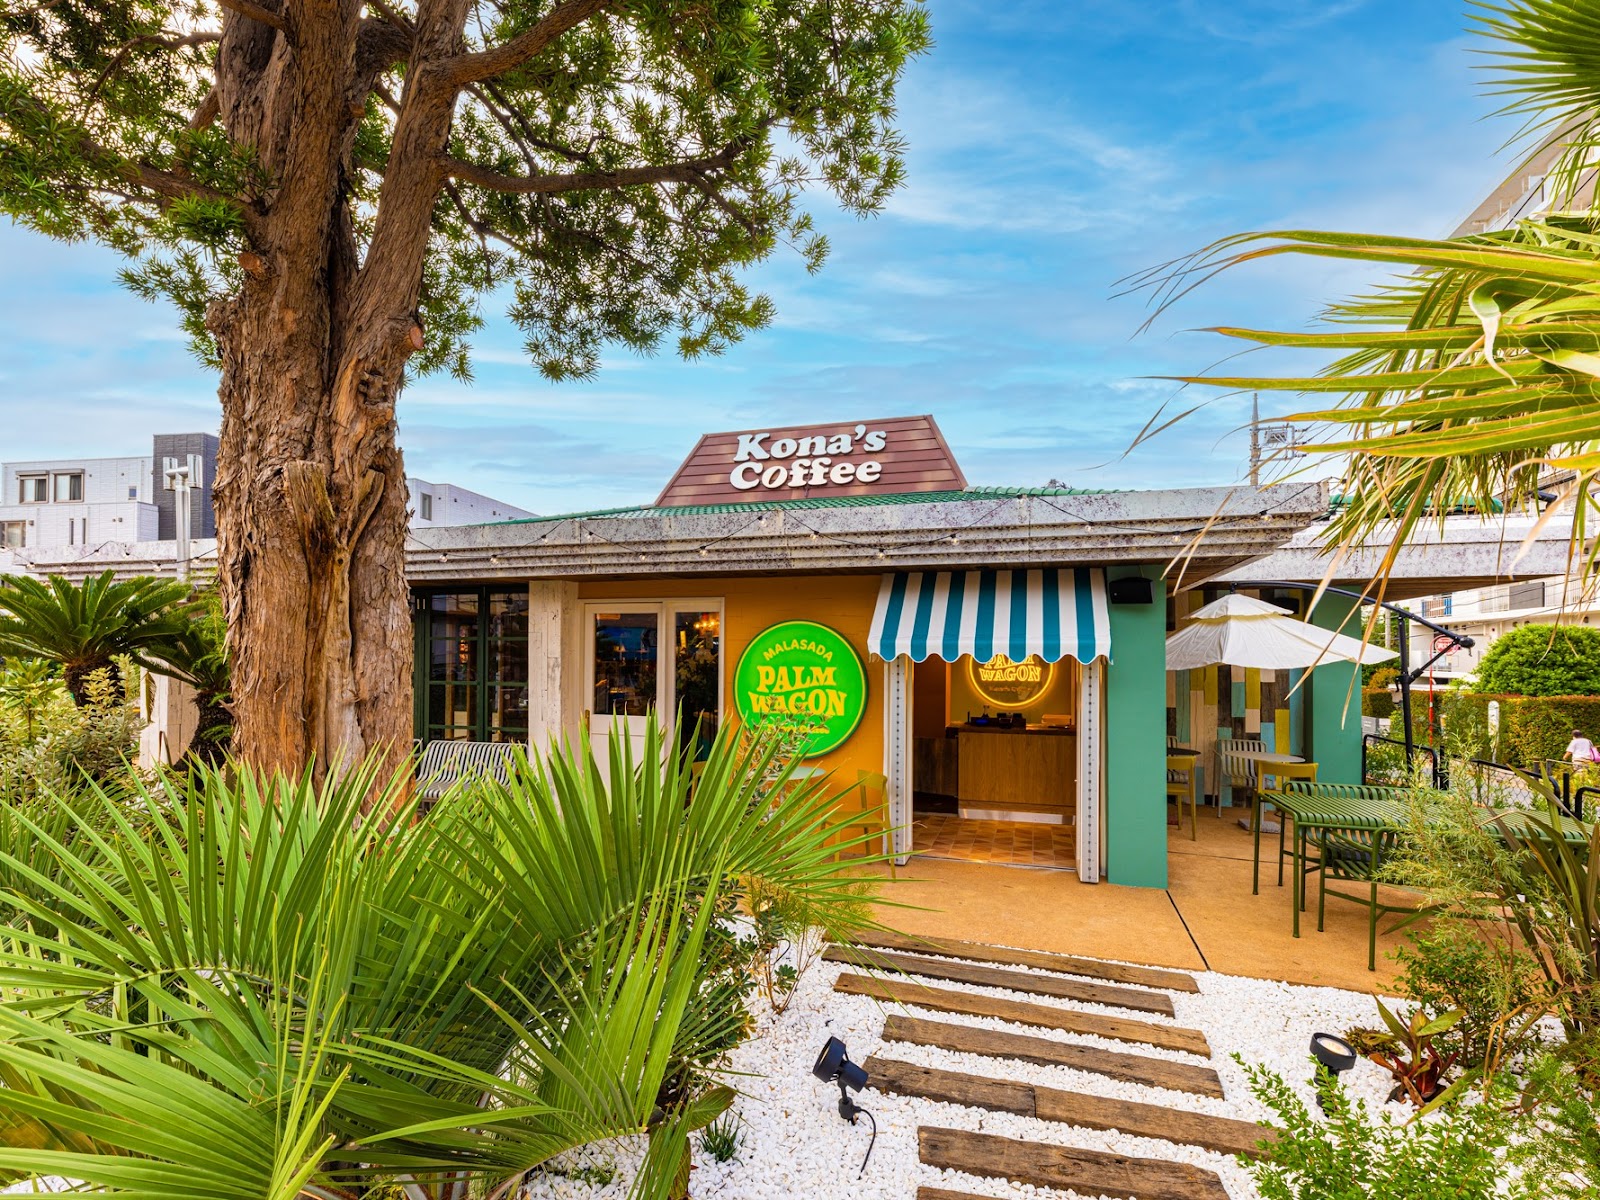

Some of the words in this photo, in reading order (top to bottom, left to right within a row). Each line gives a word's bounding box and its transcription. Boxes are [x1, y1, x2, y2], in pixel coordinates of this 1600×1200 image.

[733, 424, 887, 462] Kona's
[729, 457, 882, 490] Coffee
[763, 639, 833, 662] MALASADA
[756, 666, 837, 693] PALM
[979, 665, 1041, 681] WAGON
[748, 688, 847, 716] WAGON
